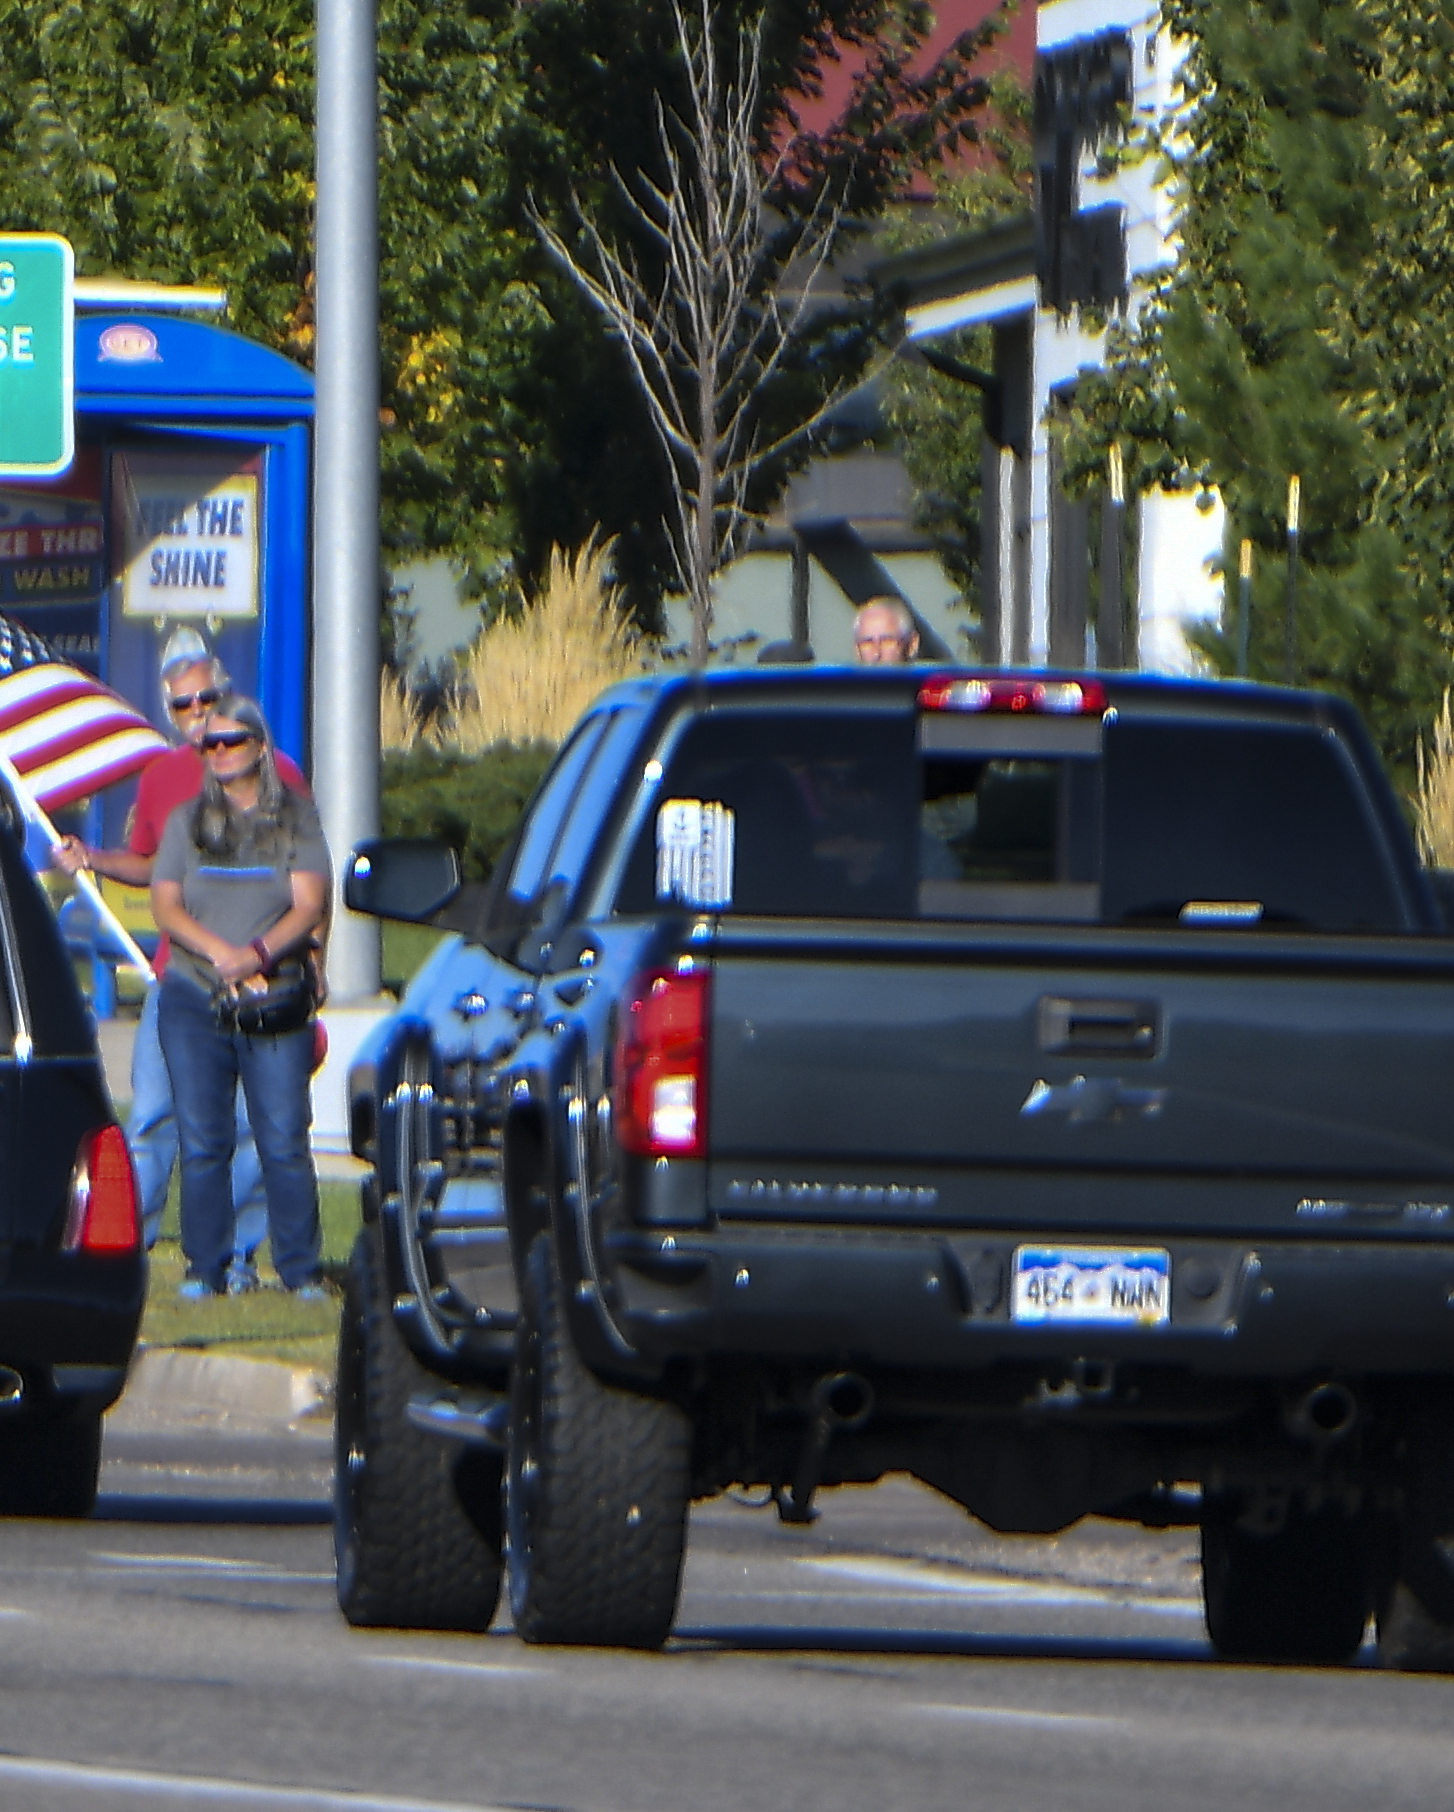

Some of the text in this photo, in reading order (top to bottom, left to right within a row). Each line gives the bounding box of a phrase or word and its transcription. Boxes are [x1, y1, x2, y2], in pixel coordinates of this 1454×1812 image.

[197, 498, 244, 536] THE
[14, 566, 91, 590] WASH
[149, 549, 228, 587] SHINE
